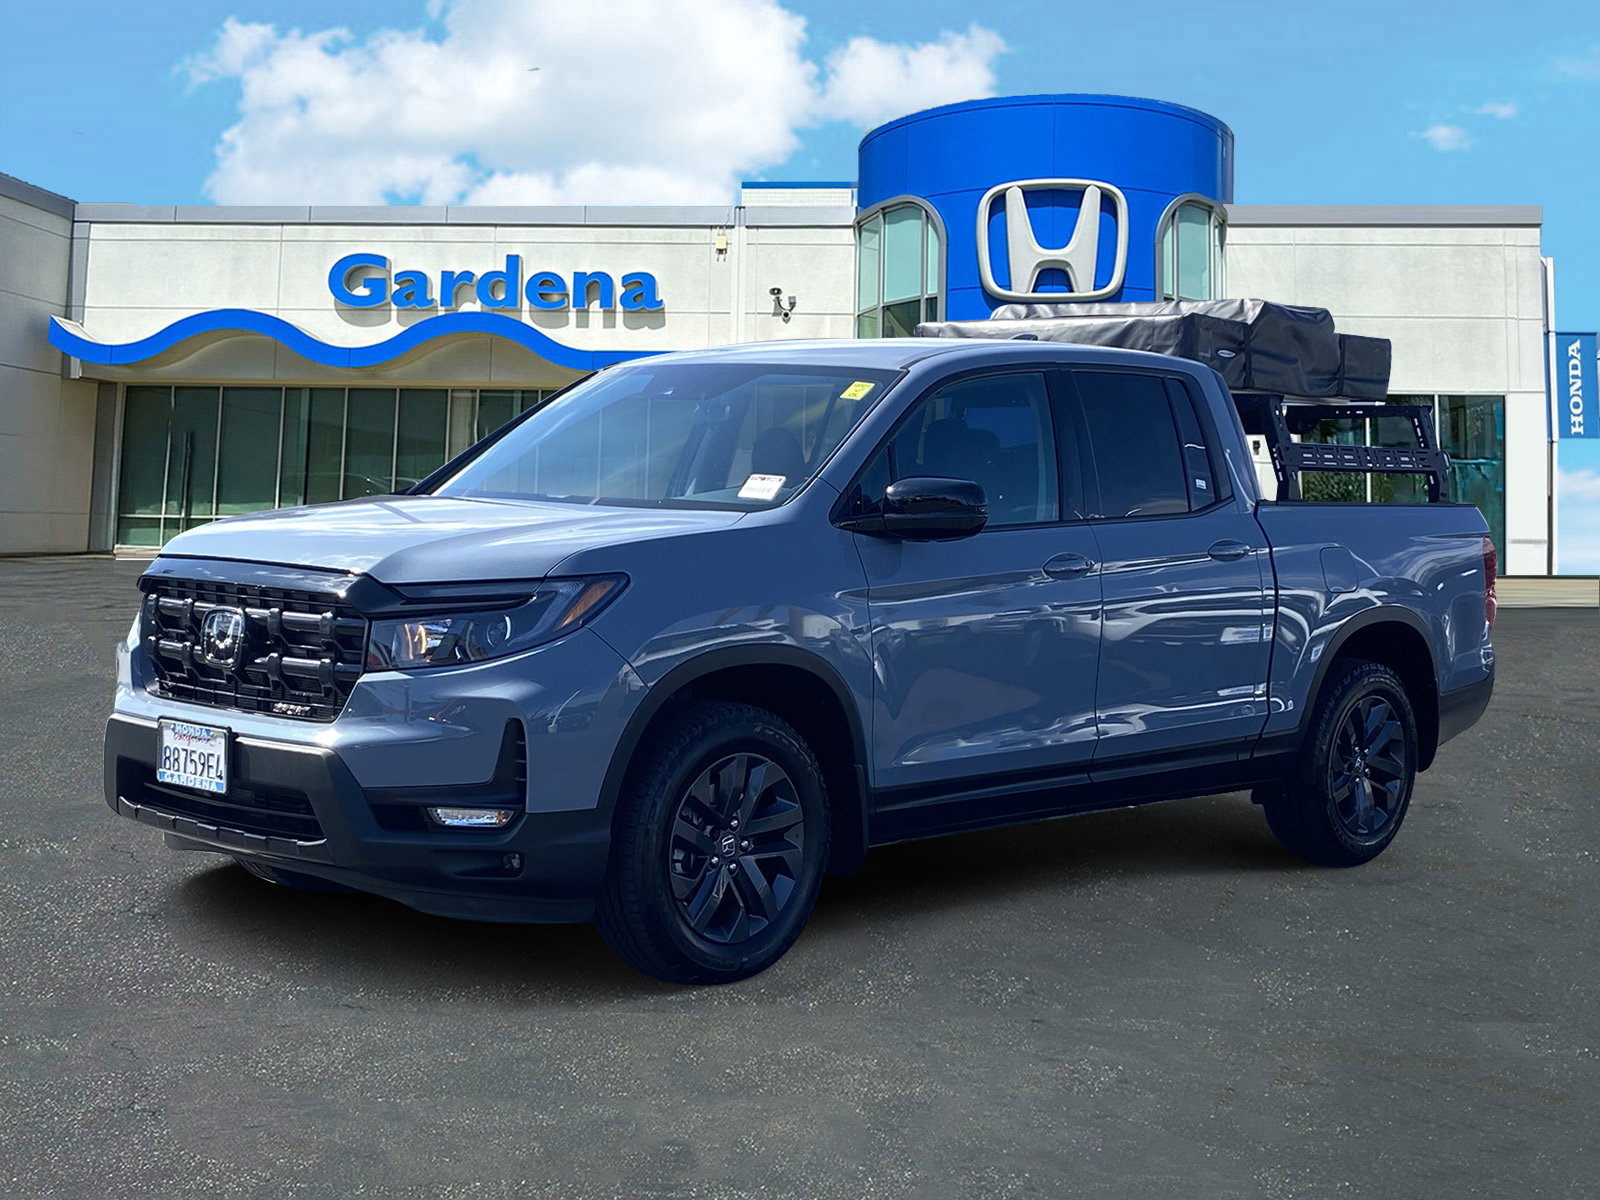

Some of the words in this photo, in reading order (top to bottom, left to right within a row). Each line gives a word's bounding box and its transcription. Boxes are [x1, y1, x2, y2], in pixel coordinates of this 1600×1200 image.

[328, 253, 663, 310] Gardena
[1568, 339, 1584, 435] HONDA
[174, 722, 210, 737] HONDA
[163, 744, 224, 781] 88759E4
[163, 773, 218, 791] GARDENA
